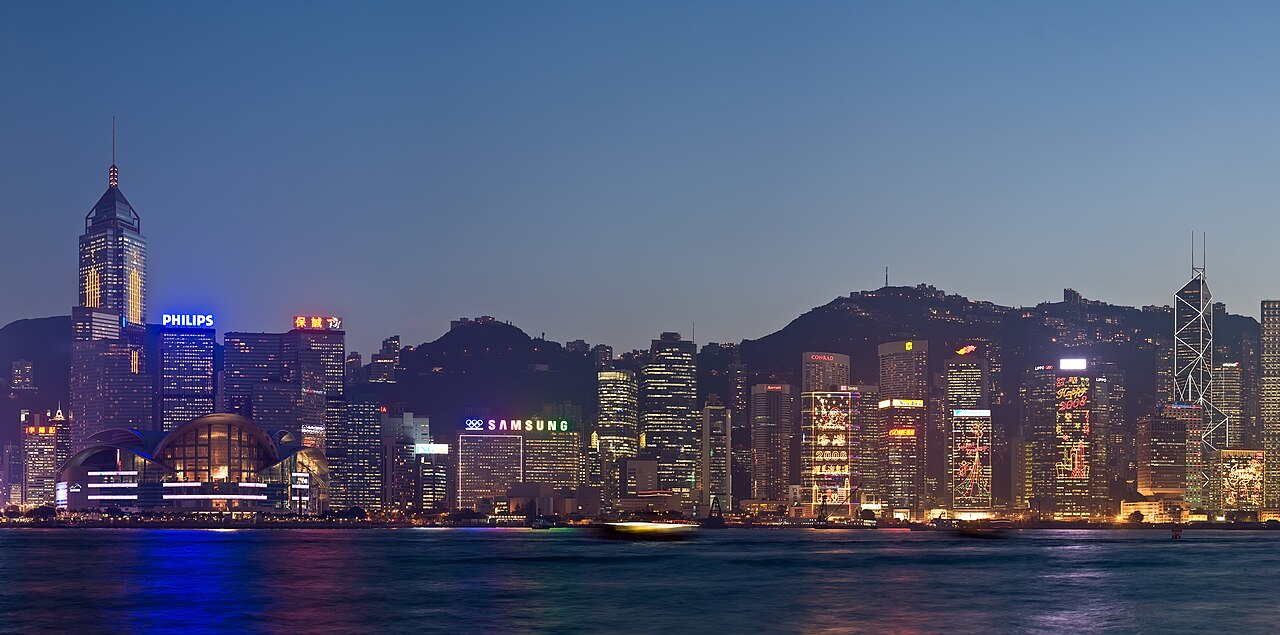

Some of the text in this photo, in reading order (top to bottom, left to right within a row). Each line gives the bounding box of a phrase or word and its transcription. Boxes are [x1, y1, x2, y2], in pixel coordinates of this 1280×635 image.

[163, 315, 213, 326] PHILIPS
[1059, 396, 1087, 411] 2008
[488, 420, 567, 431] SAMSUNG
[816, 451, 847, 461] 2008
